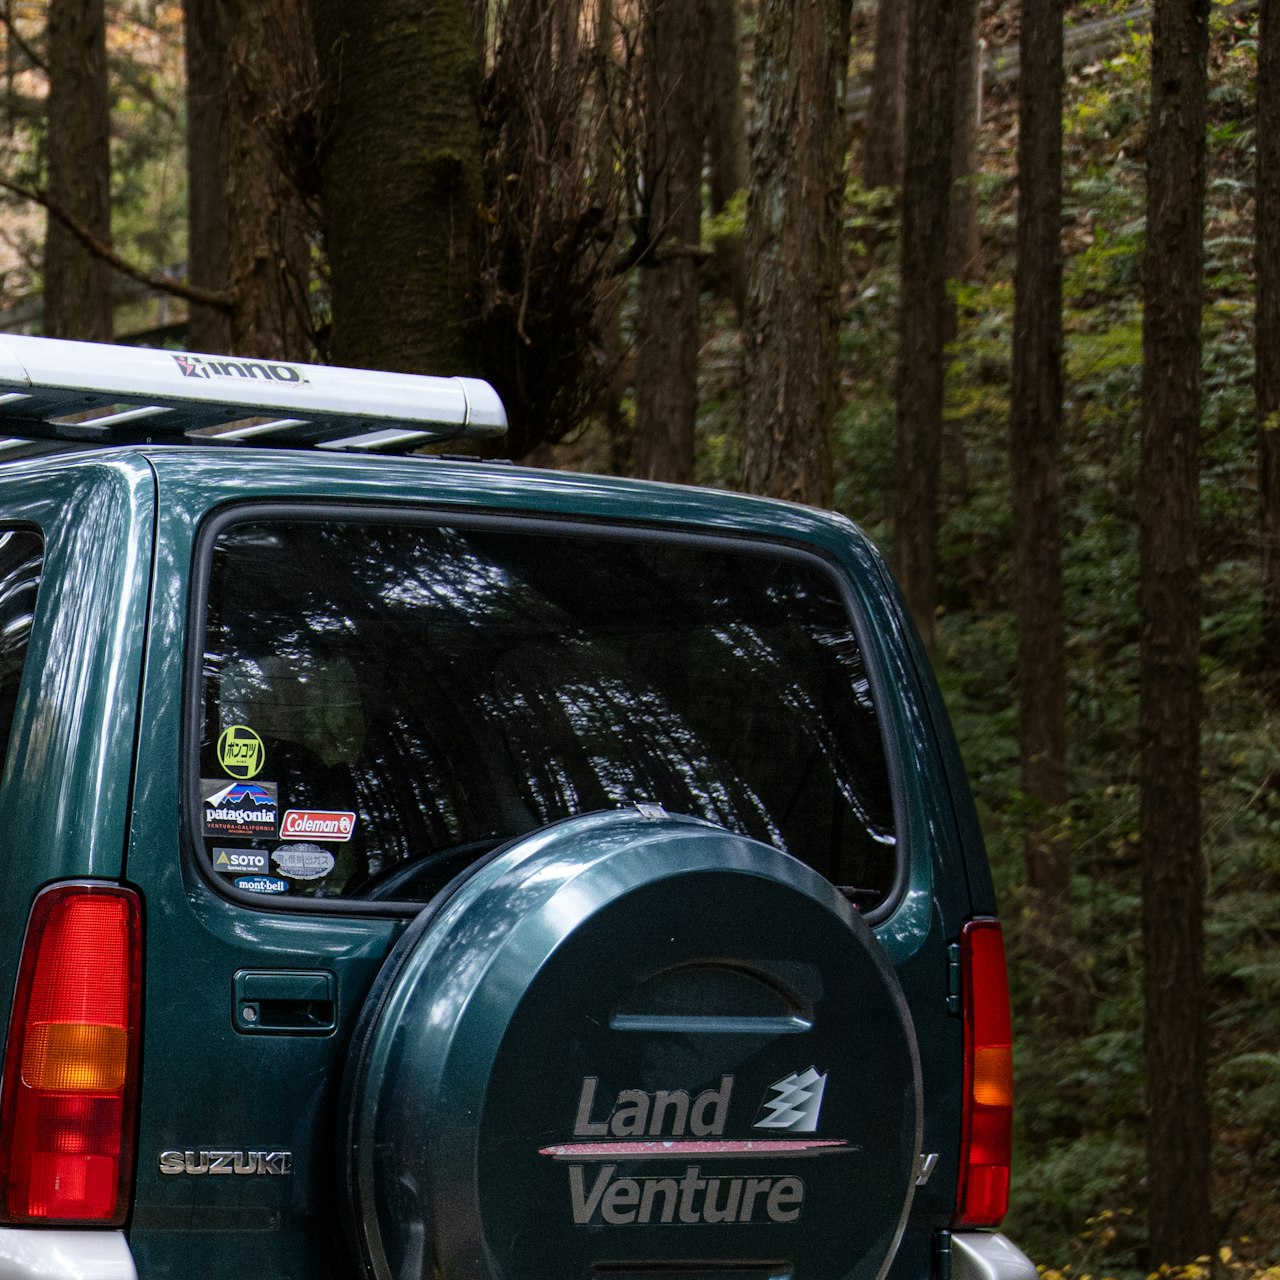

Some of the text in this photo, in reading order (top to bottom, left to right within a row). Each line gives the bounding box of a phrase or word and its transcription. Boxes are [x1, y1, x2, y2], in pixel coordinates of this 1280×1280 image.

[205, 807, 275, 824] patagonia
[287, 813, 339, 833] Coleman
[230, 854, 264, 866] SOTO
[572, 1075, 735, 1136] Land
[159, 1151, 293, 1176] SUZUKI
[568, 1164, 805, 1224] Venture
